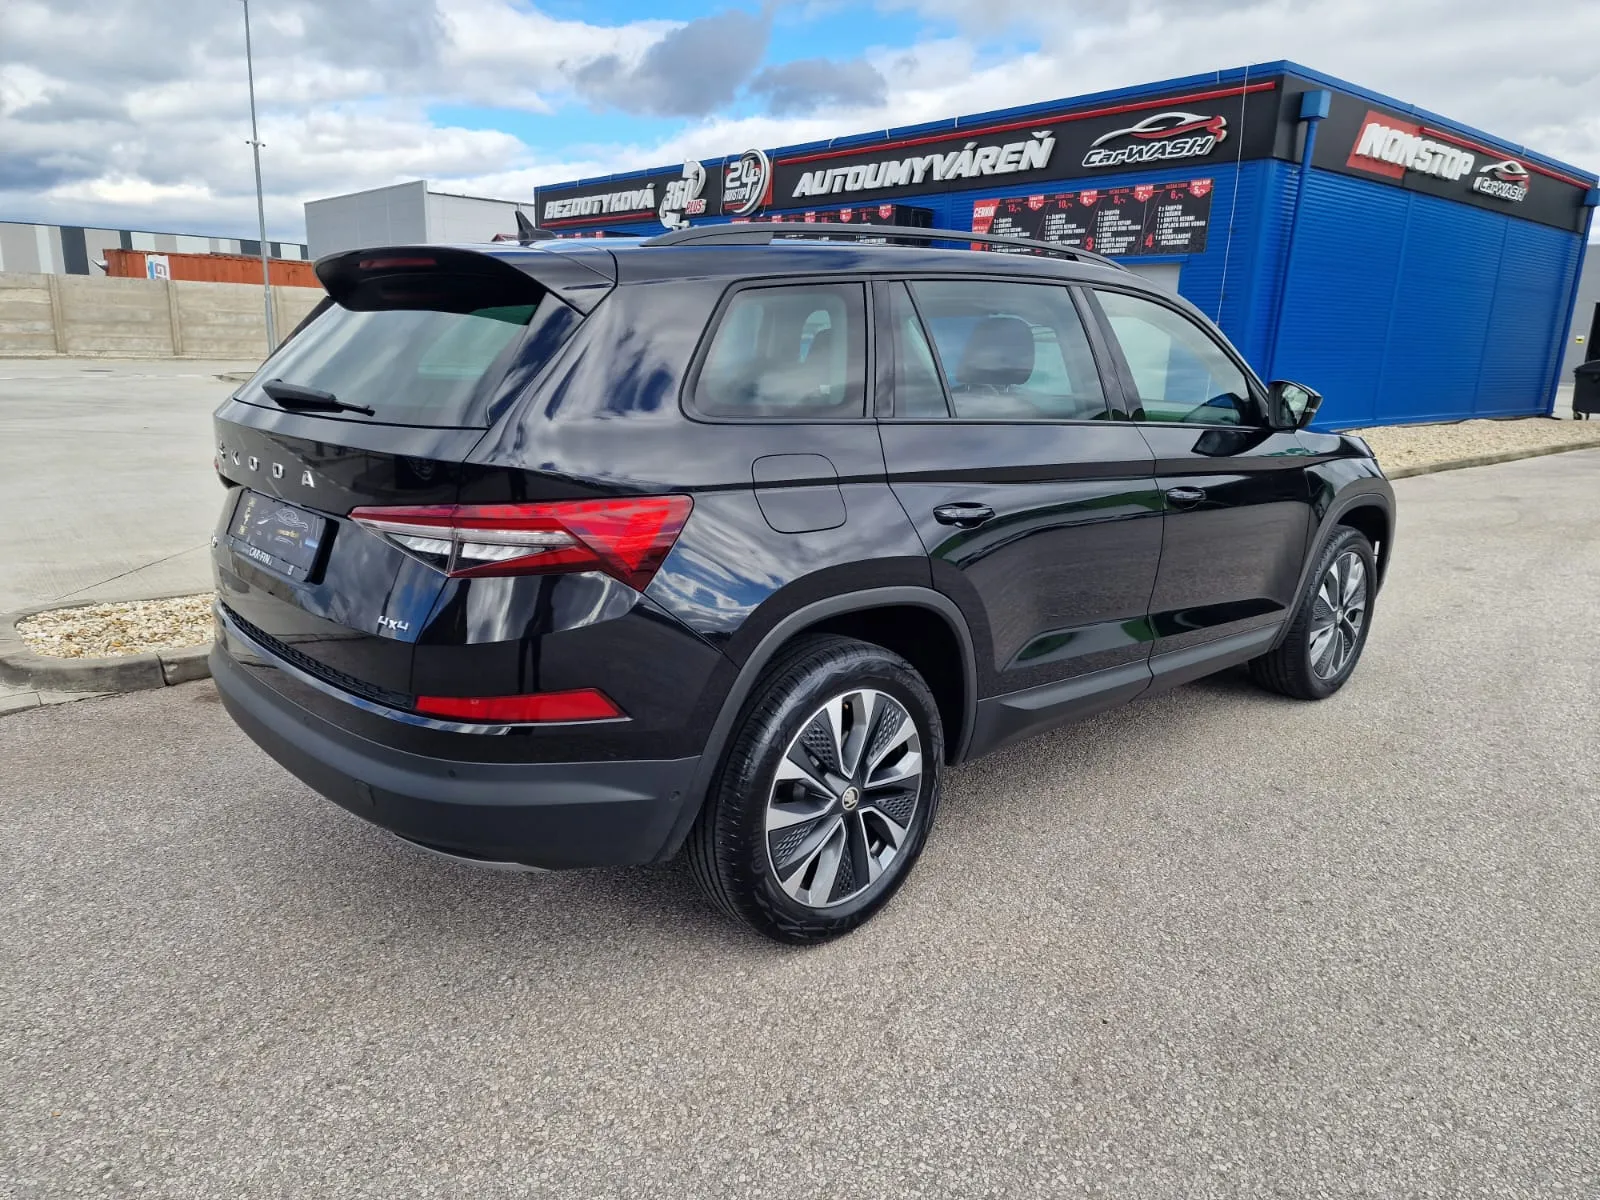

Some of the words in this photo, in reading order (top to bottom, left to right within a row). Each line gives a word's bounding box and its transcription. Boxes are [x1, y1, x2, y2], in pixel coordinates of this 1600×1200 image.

[792, 130, 1056, 197] AUTOUMYVÁREŇ
[1082, 135, 1217, 168] CarWASH
[1355, 123, 1475, 181] NONSTOP
[544, 183, 656, 220] BEZDOTYKOVÁ
